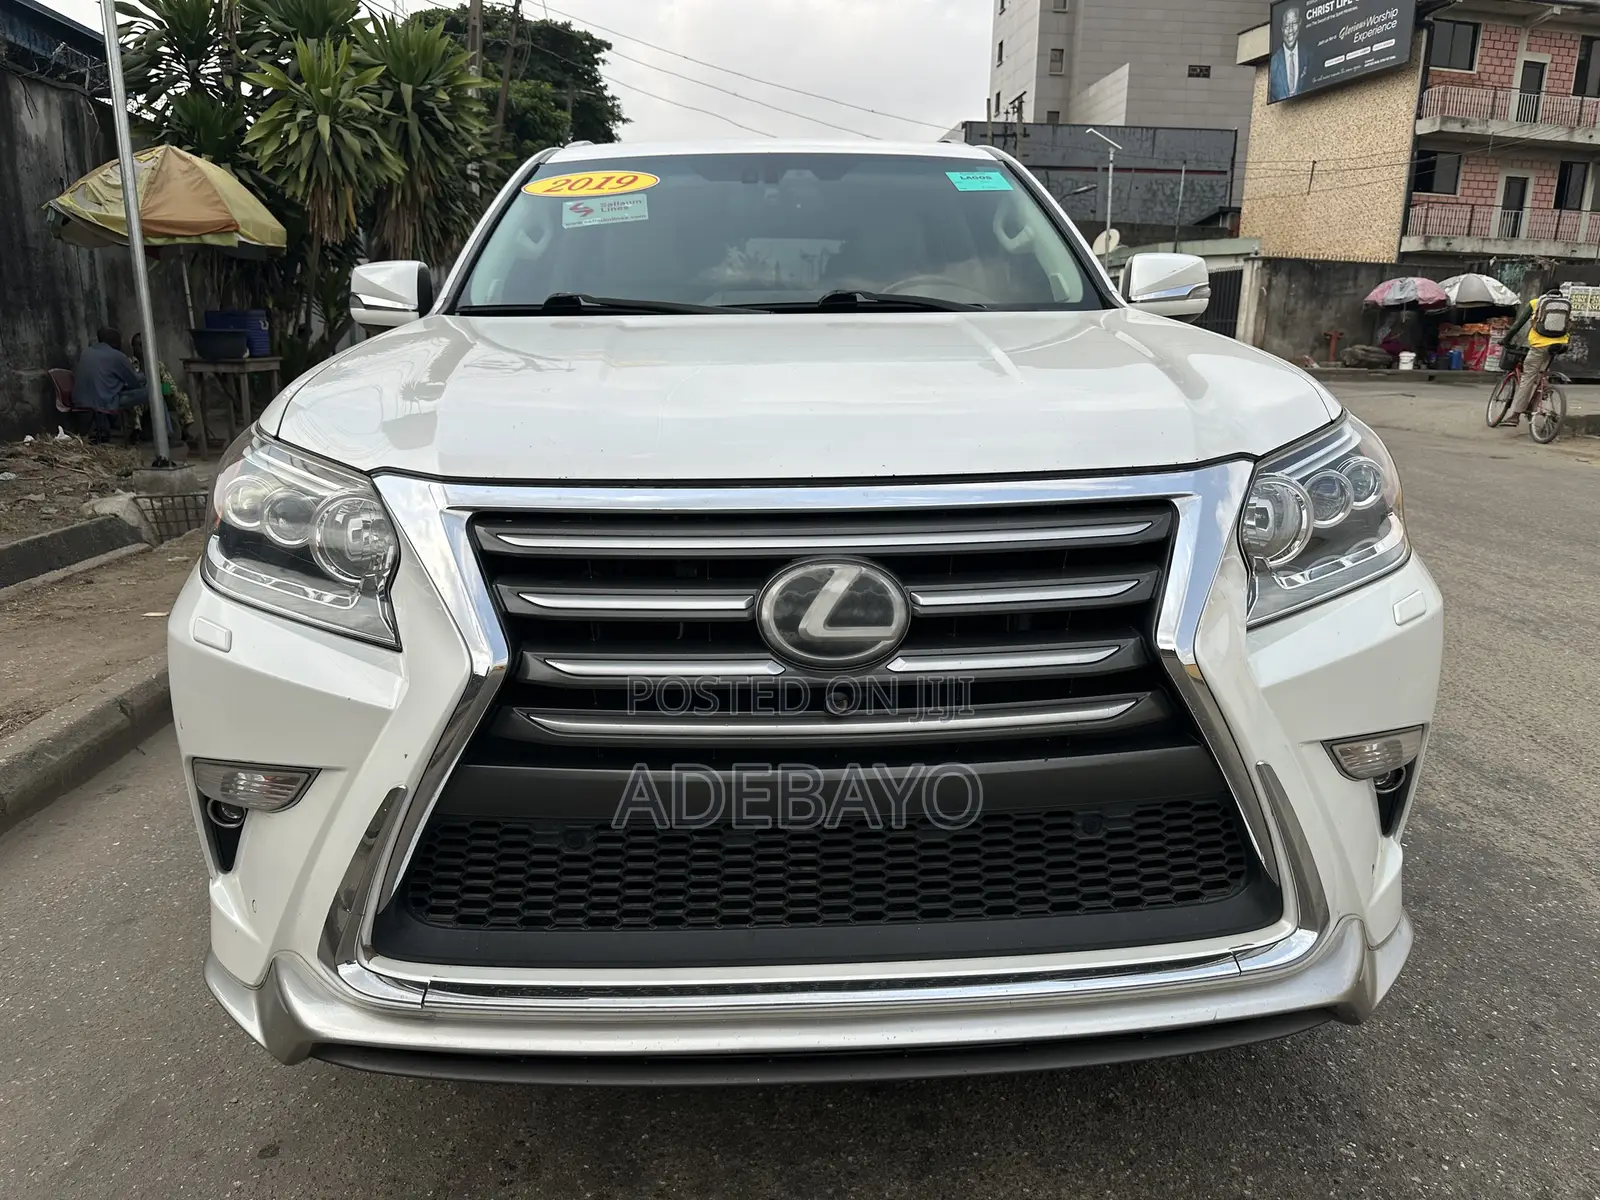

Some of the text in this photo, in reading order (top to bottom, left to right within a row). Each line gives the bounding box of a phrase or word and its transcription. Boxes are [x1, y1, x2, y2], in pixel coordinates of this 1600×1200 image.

[1306, 0, 1335, 20] CHRIST
[1339, 22, 1366, 40] Glorious
[1366, 8, 1398, 27] Worship
[1353, 19, 1398, 43] Experience
[544, 175, 639, 193] 2019
[601, 205, 630, 213] Lines
